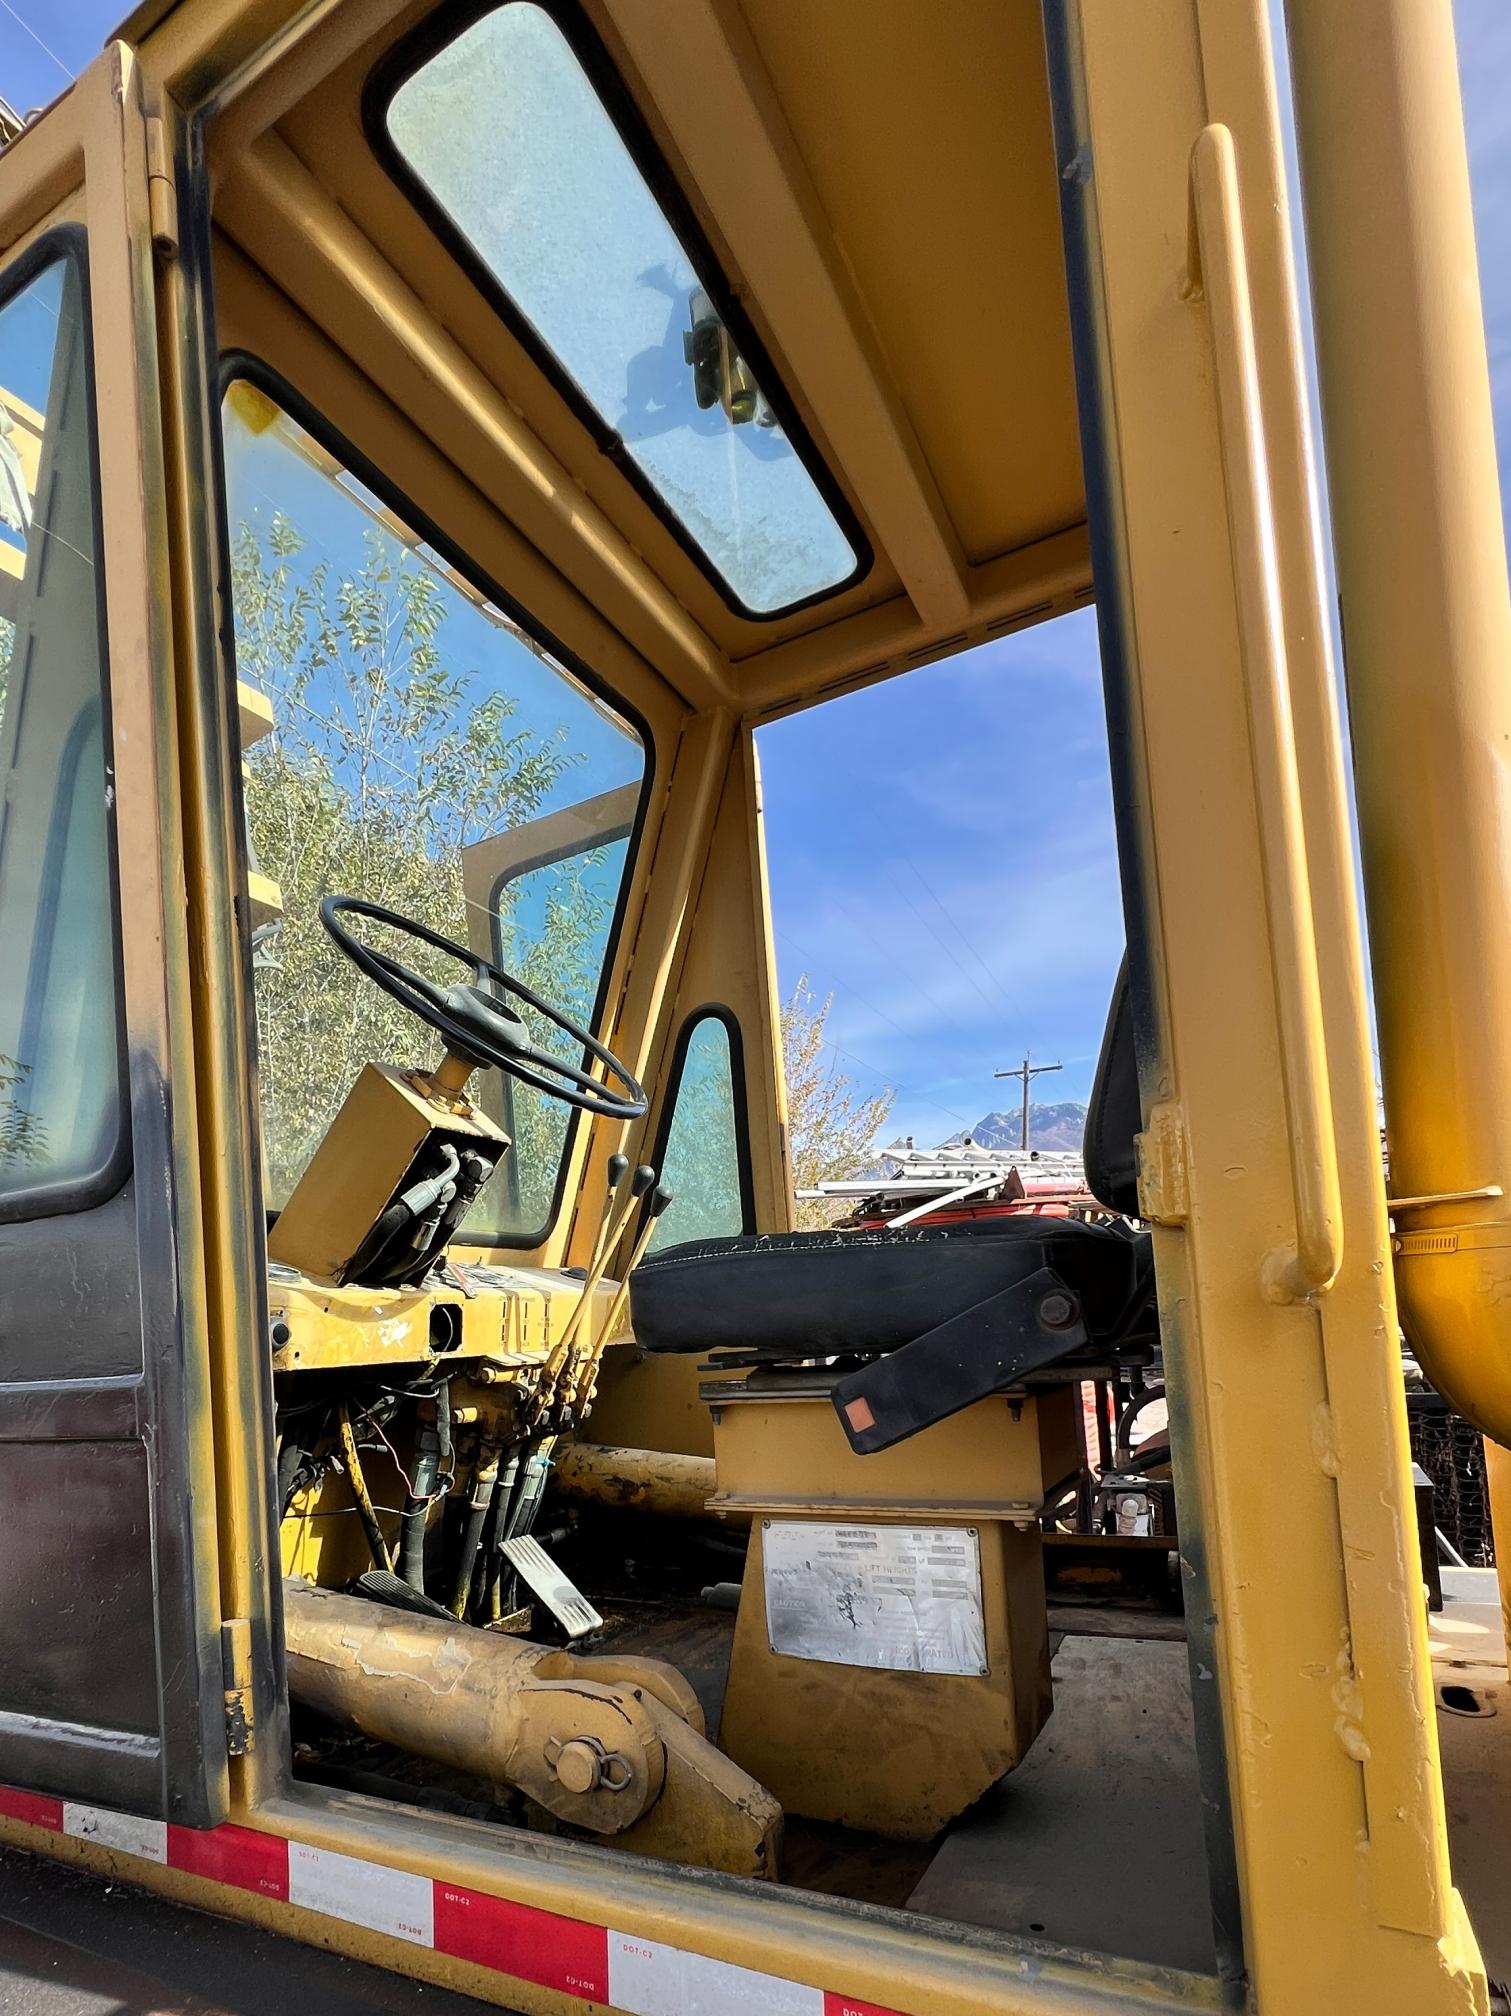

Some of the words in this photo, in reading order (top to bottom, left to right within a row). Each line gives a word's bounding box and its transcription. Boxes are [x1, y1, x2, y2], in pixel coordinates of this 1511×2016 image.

[444, 1892, 471, 1906] DOT-C2
[622, 1943, 654, 1959] DOT-C2
[565, 1975, 595, 1992] DOT-C2
